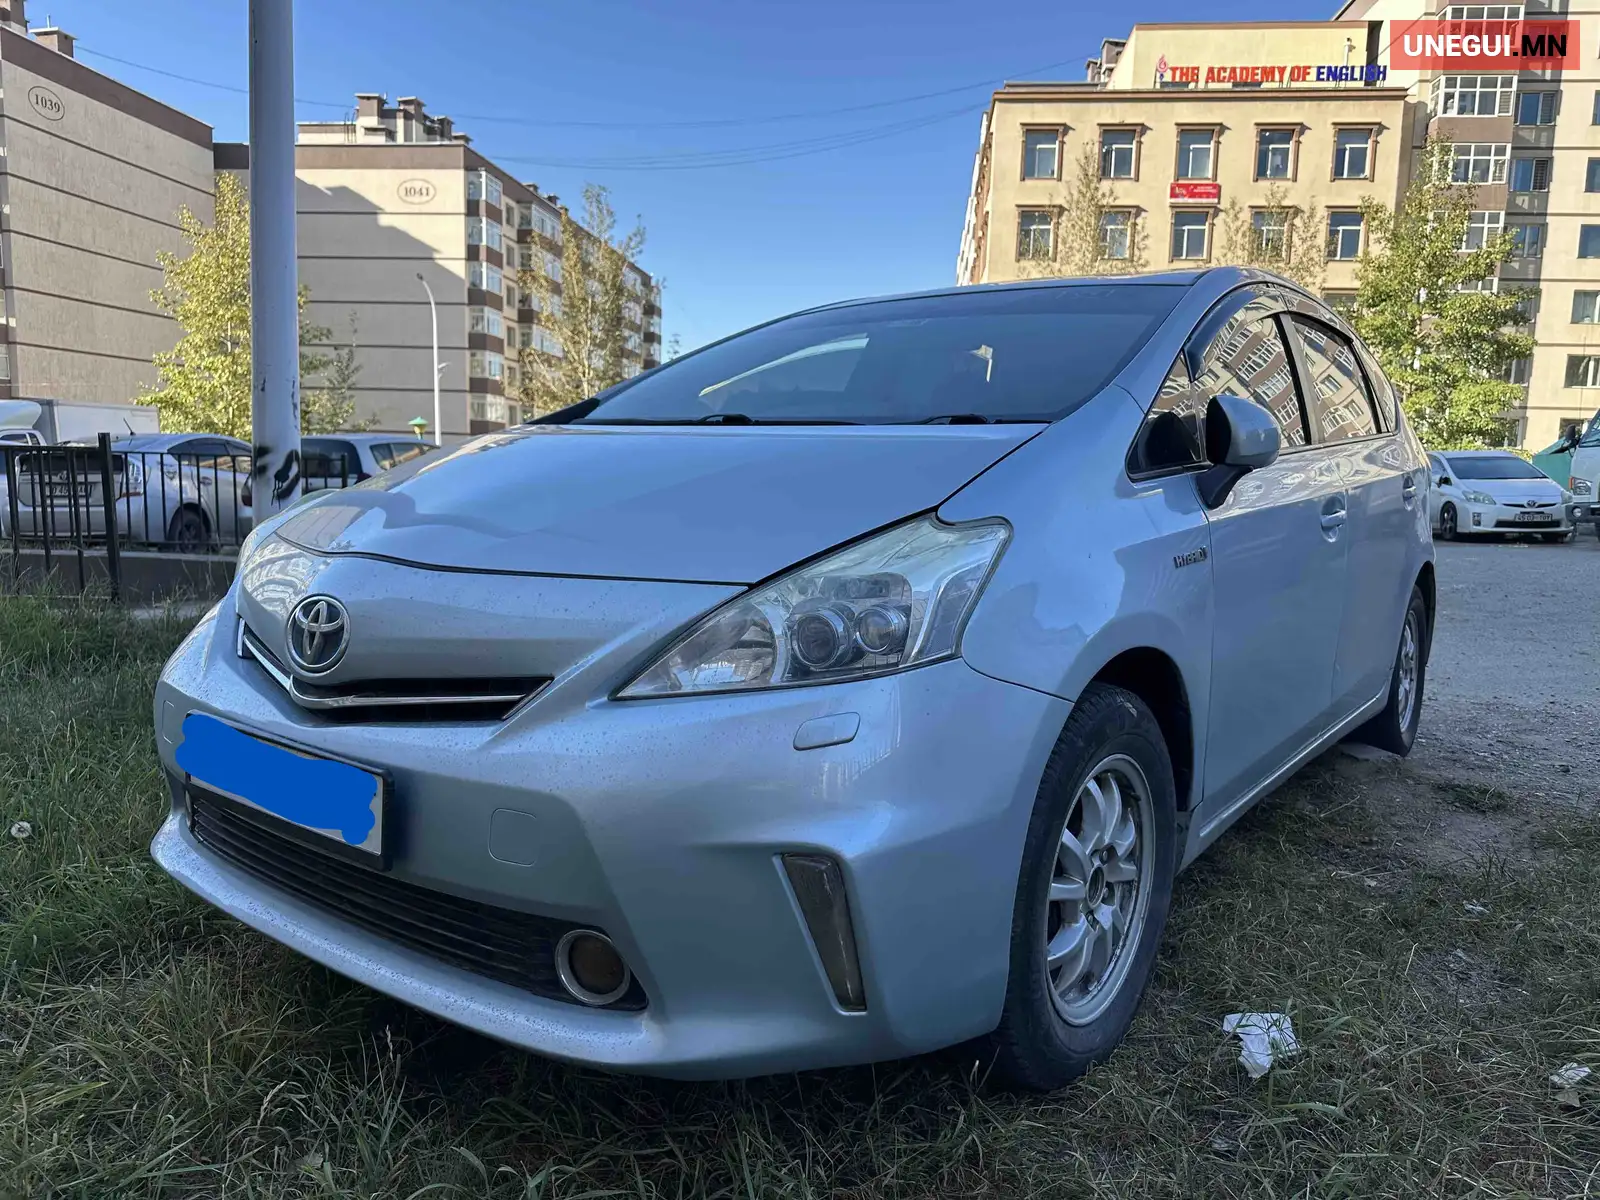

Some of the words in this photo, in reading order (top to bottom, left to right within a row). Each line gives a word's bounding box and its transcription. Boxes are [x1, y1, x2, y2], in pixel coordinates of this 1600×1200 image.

[1169, 66, 1199, 83] THE
[1205, 66, 1287, 83] ACADEMY
[1290, 66, 1312, 82] OF
[1316, 65, 1387, 82] ENGLISH
[35, 93, 61, 113] 1039
[404, 186, 430, 197] 1041
